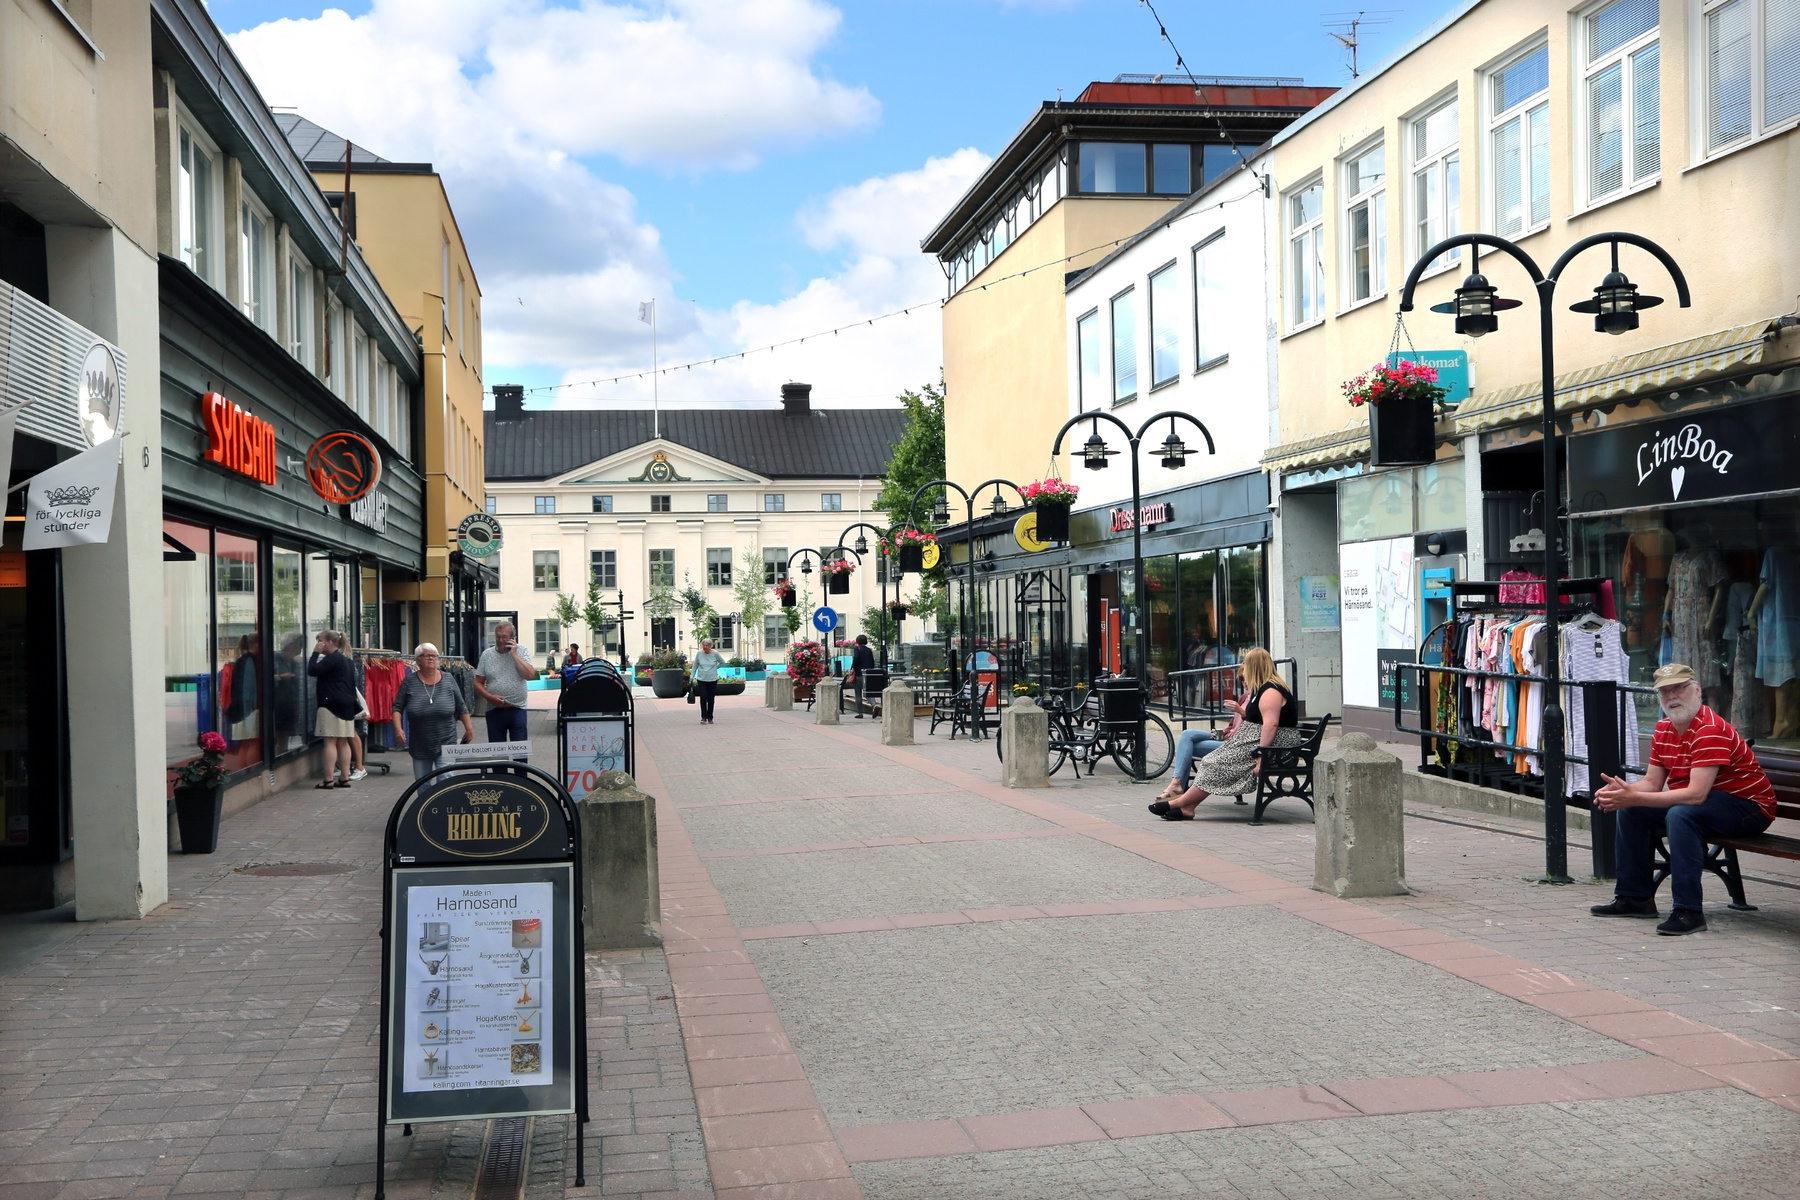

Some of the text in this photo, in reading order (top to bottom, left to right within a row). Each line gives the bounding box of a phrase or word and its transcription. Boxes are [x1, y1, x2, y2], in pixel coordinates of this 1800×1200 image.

[203, 392, 276, 486] SYNSAM
[142, 446, 149, 468] 6
[1637, 423, 1733, 487] LinBoa
[35, 508, 101, 520] för lyckliga
[43, 521, 91, 534] stunder
[460, 514, 499, 532] ESPRESSO
[464, 544, 496, 555] HOUSE
[1344, 584, 1368, 598] Vi tror på
[1344, 598, 1374, 610] Härnösand.
[1381, 660, 1389, 673] Ny
[507, 743, 527, 751] klocka
[431, 804, 537, 815] GULDSMED
[447, 812, 522, 841] KALLING
[462, 888, 492, 897] Made in
